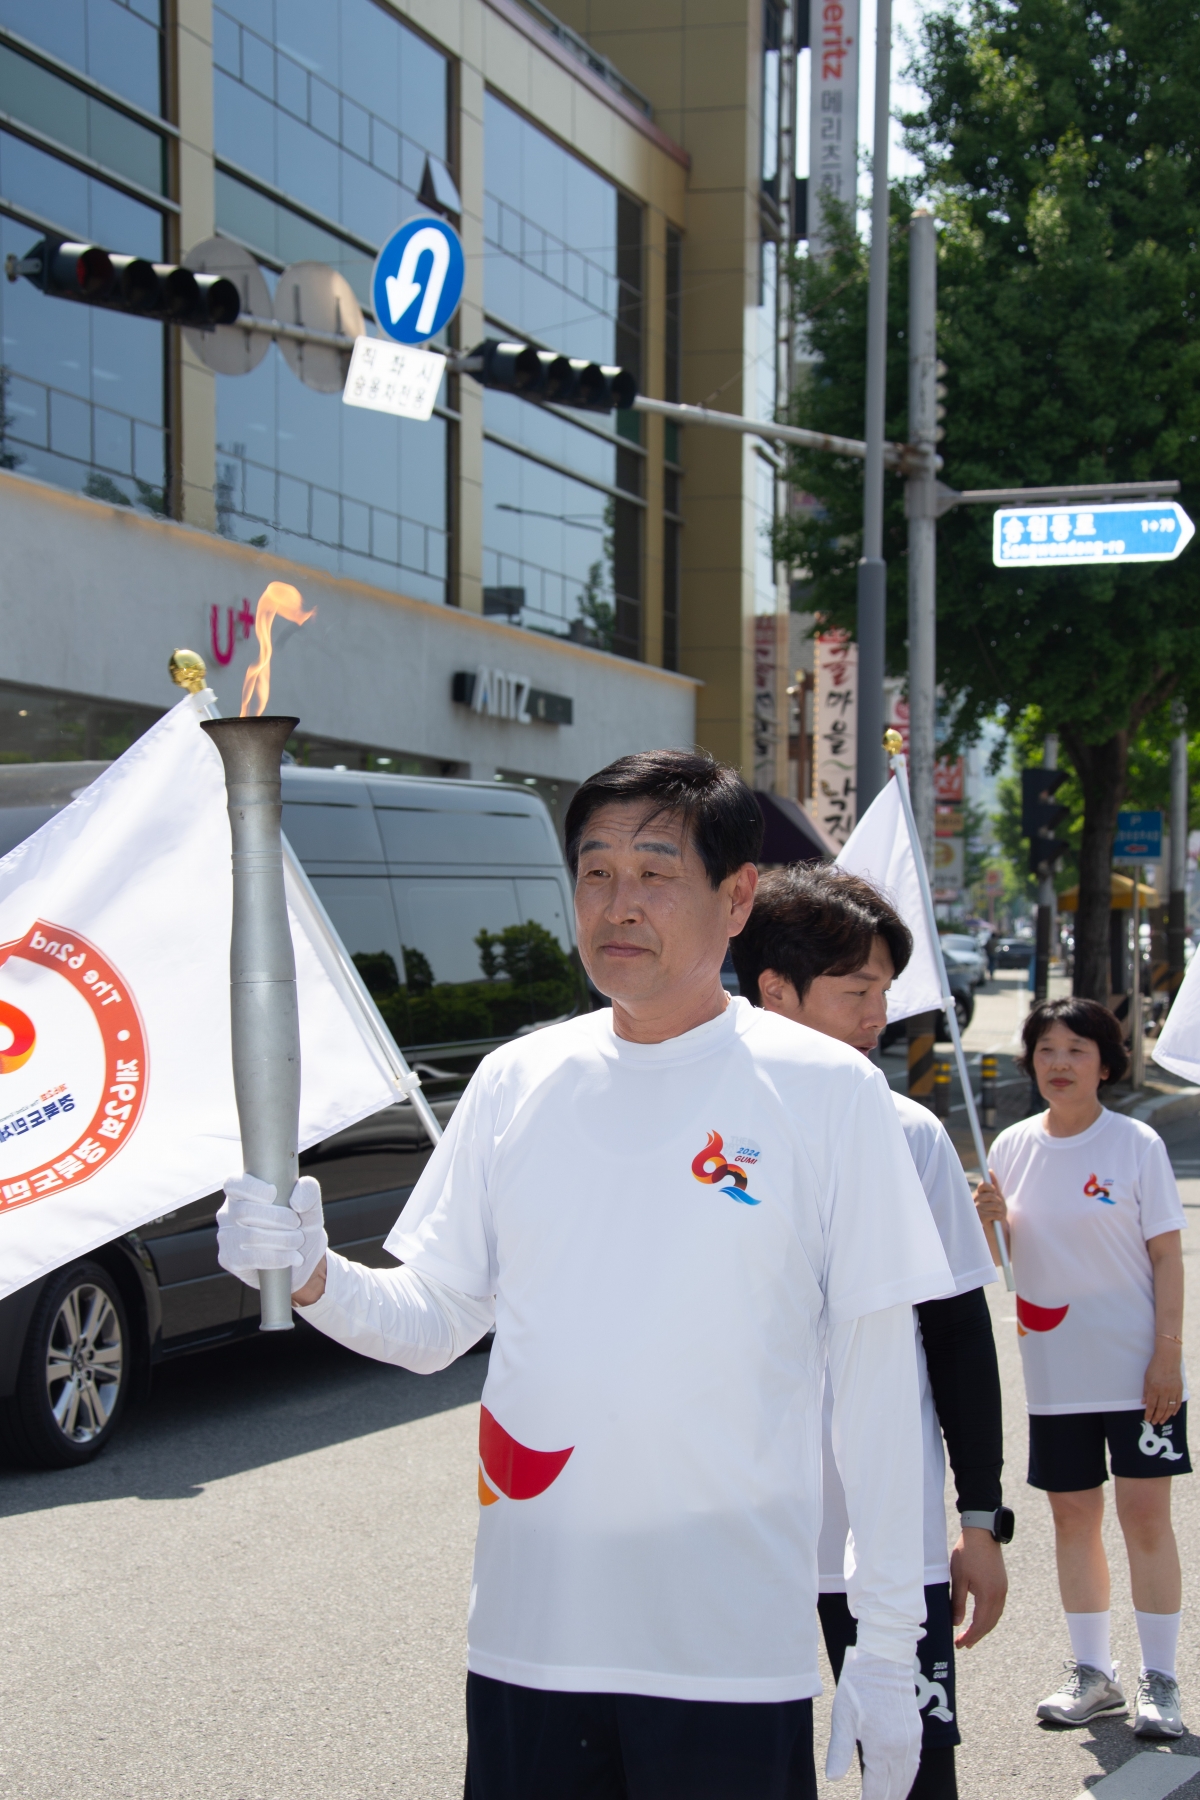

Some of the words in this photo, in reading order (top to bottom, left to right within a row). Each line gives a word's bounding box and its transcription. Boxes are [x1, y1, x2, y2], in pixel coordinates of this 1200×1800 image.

[822, 0, 853, 80] eritz
[209, 597, 255, 667] U+
[735, 1155, 757, 1165] GUMI
[736, 1147, 760, 1157] 2024
